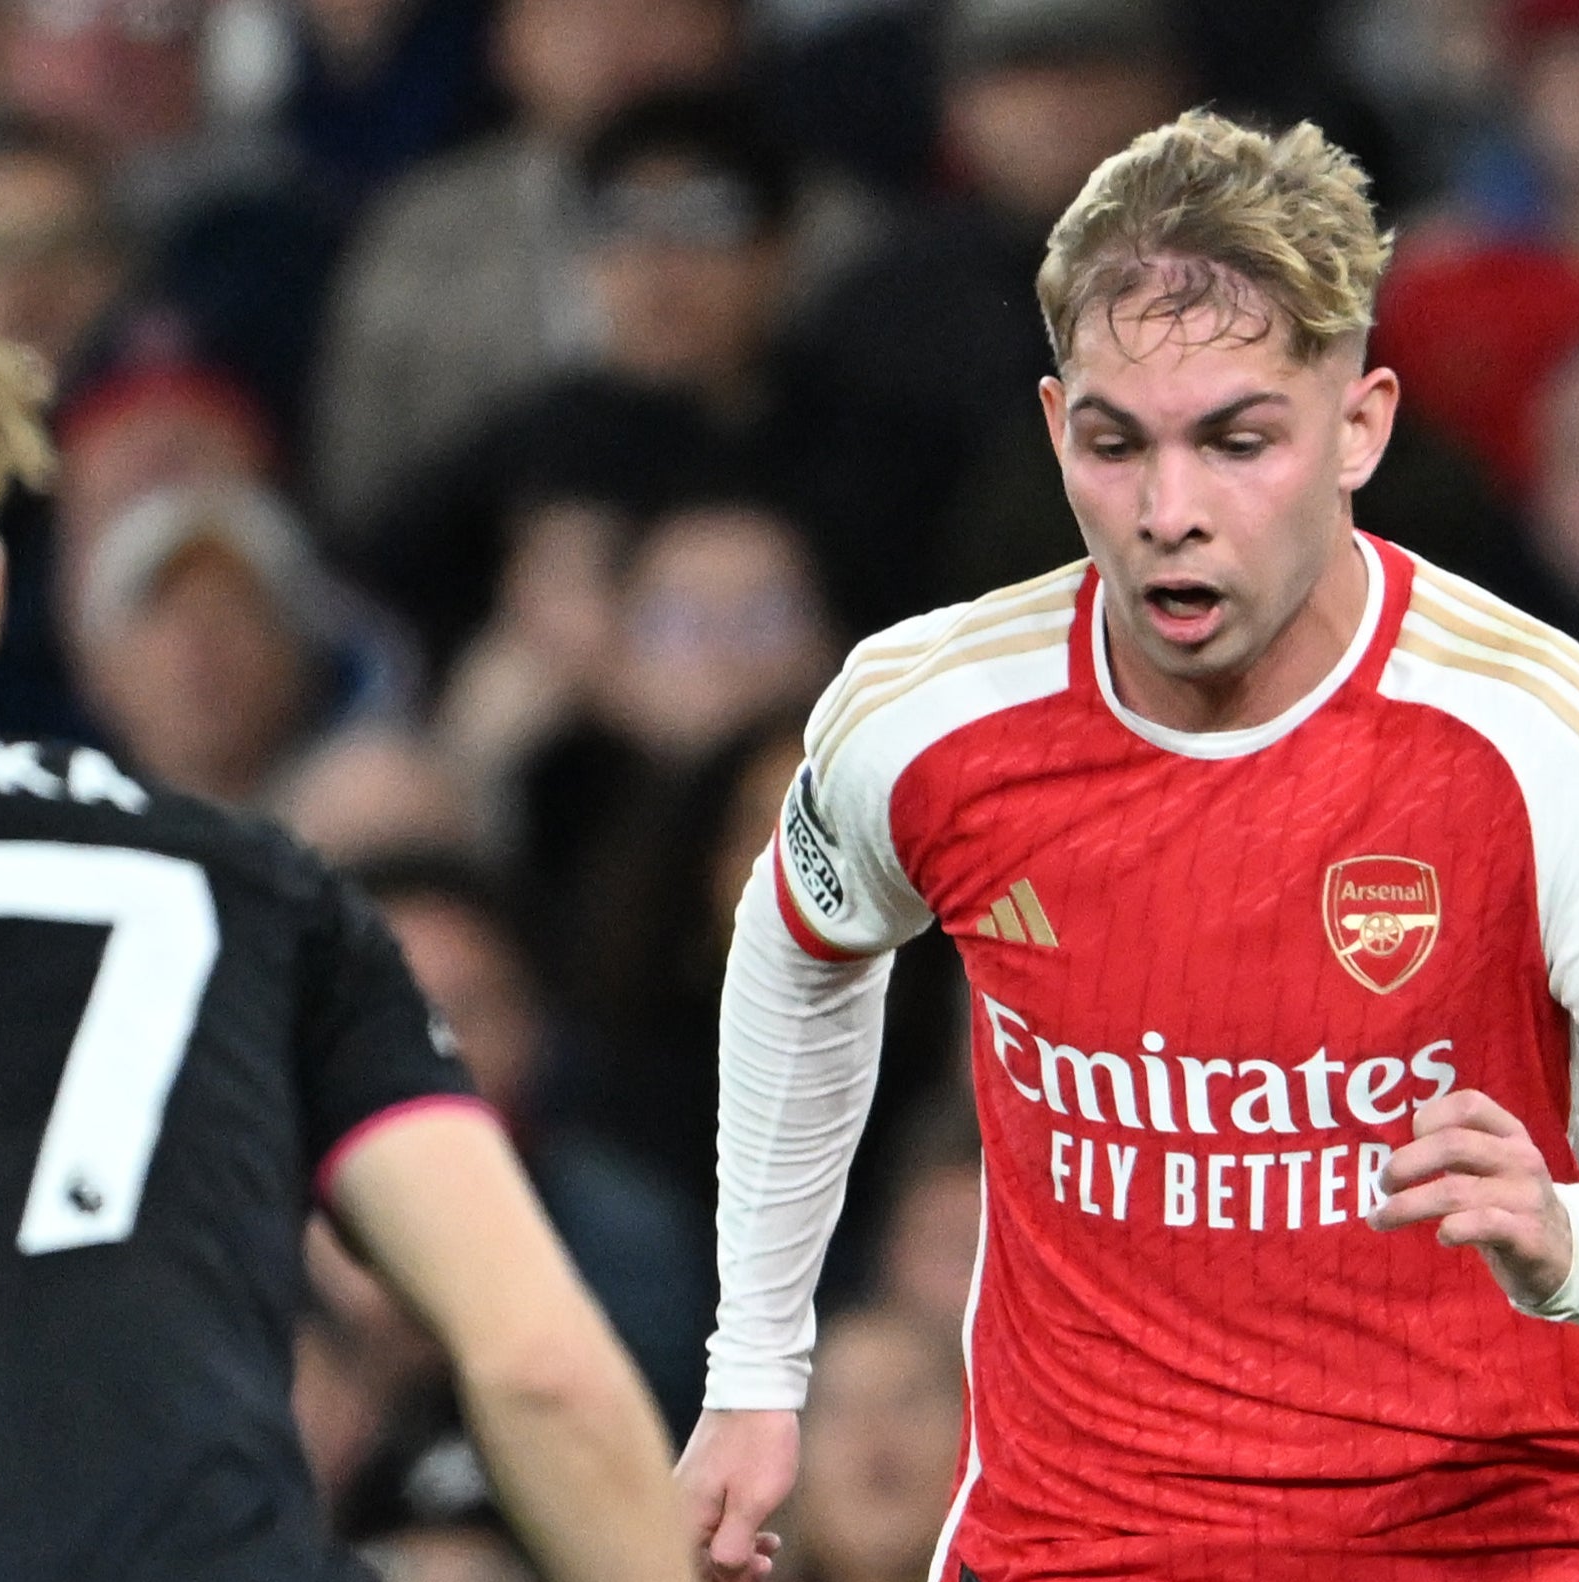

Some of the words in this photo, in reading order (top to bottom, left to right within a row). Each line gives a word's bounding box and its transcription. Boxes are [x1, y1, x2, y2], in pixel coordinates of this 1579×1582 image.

[1340, 880, 1424, 902] Arsenal
[981, 991, 1457, 1135] Emirates
[1050, 1130, 1138, 1221] FLY
[1163, 1142, 1394, 1232] BETTER
